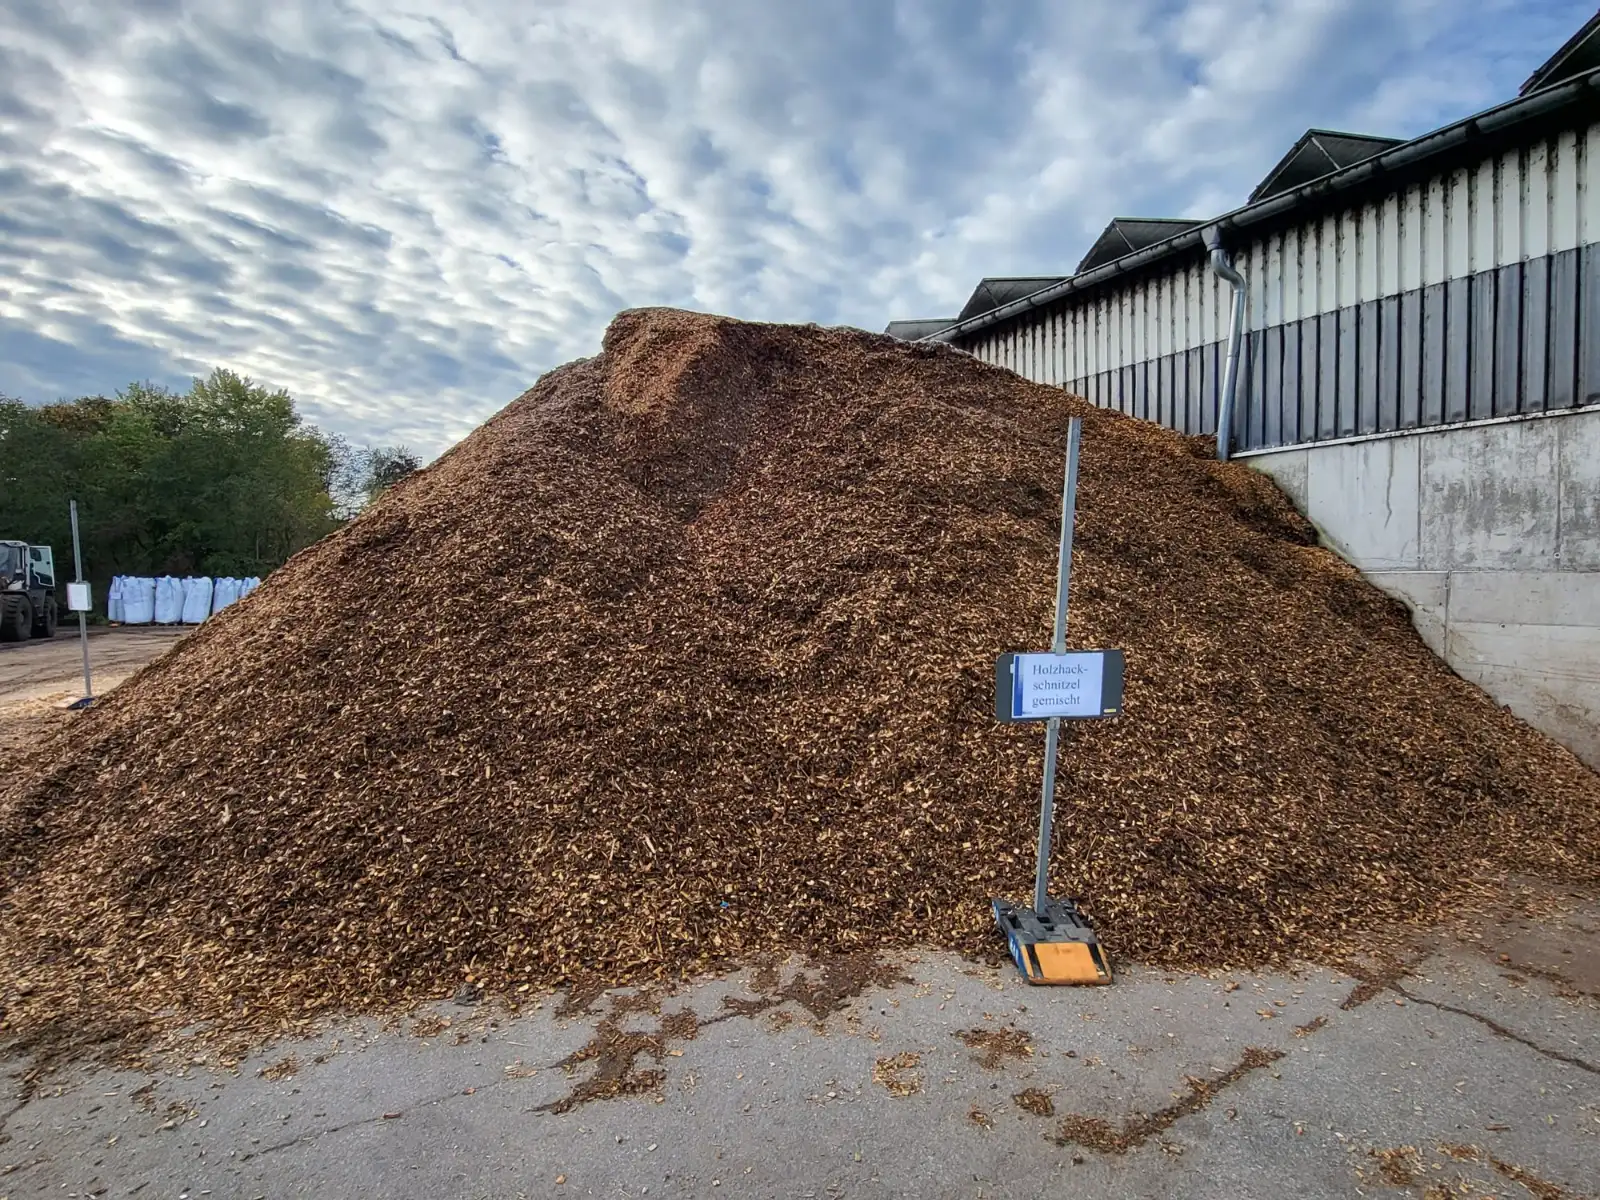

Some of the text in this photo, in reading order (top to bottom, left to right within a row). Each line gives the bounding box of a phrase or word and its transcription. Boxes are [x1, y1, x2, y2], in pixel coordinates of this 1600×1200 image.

[1033, 664, 1088, 675] Holzhack-
[1032, 679, 1080, 690] schnitzel
[1032, 694, 1081, 708] gemischt
